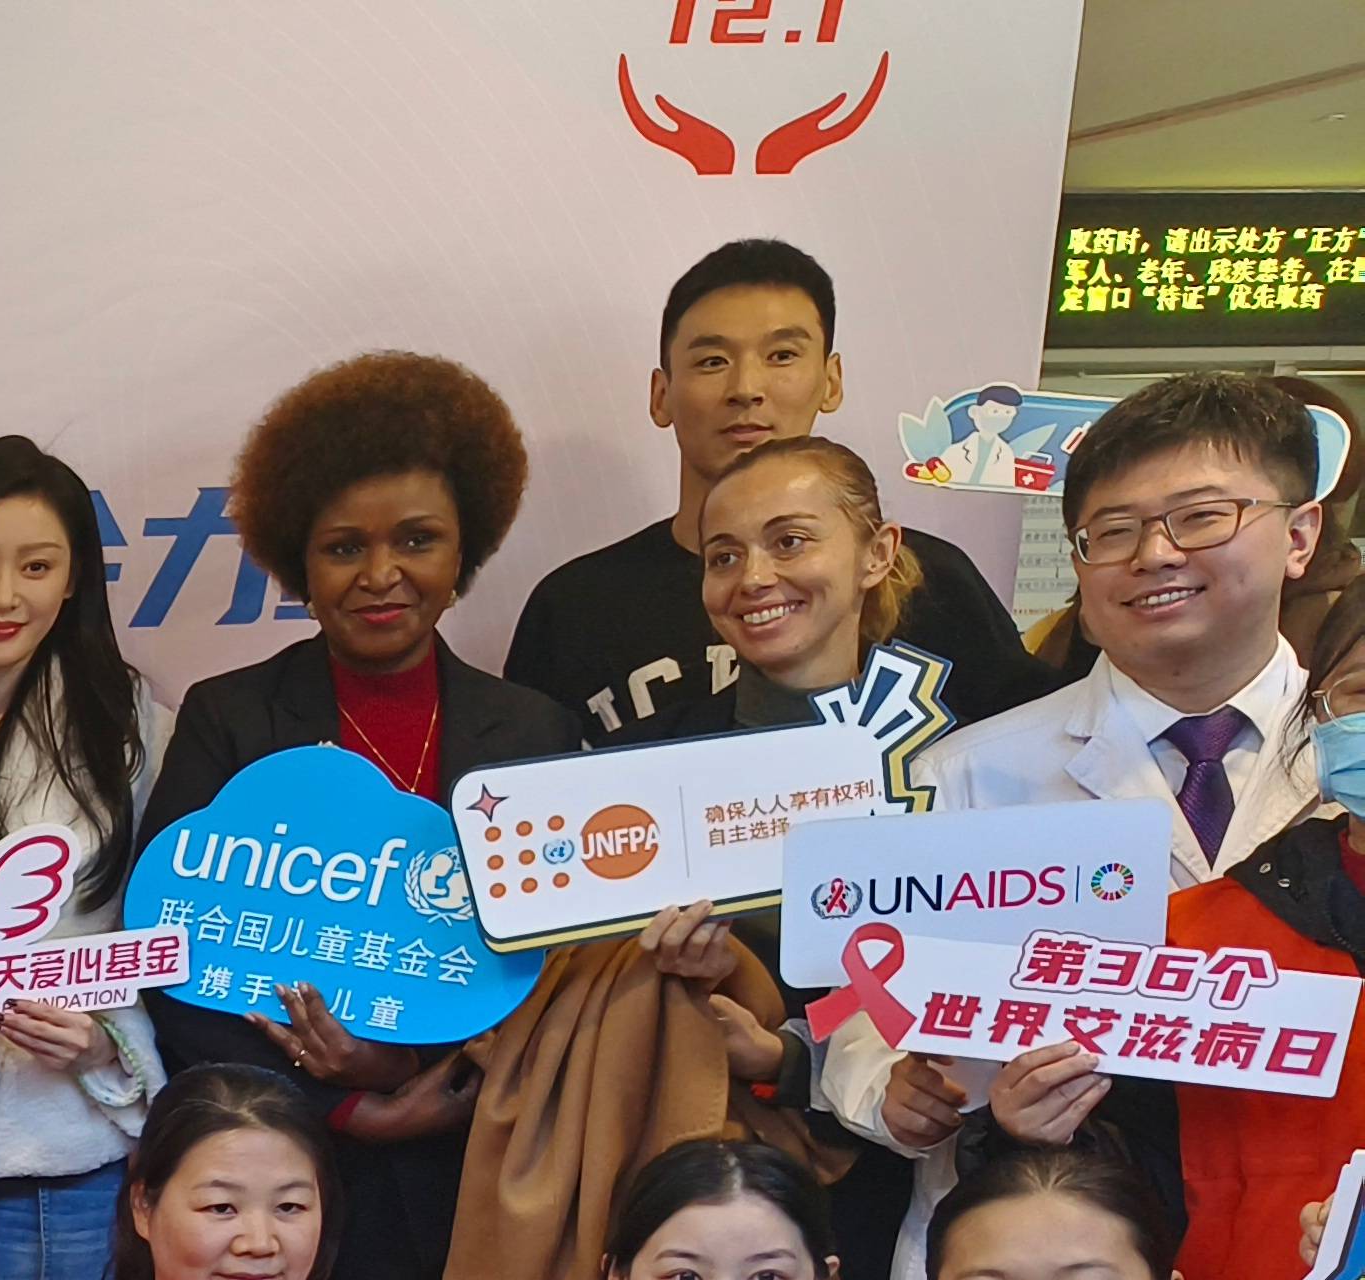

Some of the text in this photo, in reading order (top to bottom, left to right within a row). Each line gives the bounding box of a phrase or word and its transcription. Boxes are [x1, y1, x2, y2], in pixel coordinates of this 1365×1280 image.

[172, 824, 406, 907] unicef
[580, 822, 660, 861] UNFPA
[869, 866, 1067, 916] UNAIDS
[156, 898, 477, 986] 联合国儿童基金会
[1024, 936, 1270, 1003] 第36个
[197, 964, 405, 1031] 携手儿童
[919, 991, 1338, 1078] 世界艾滋病日
